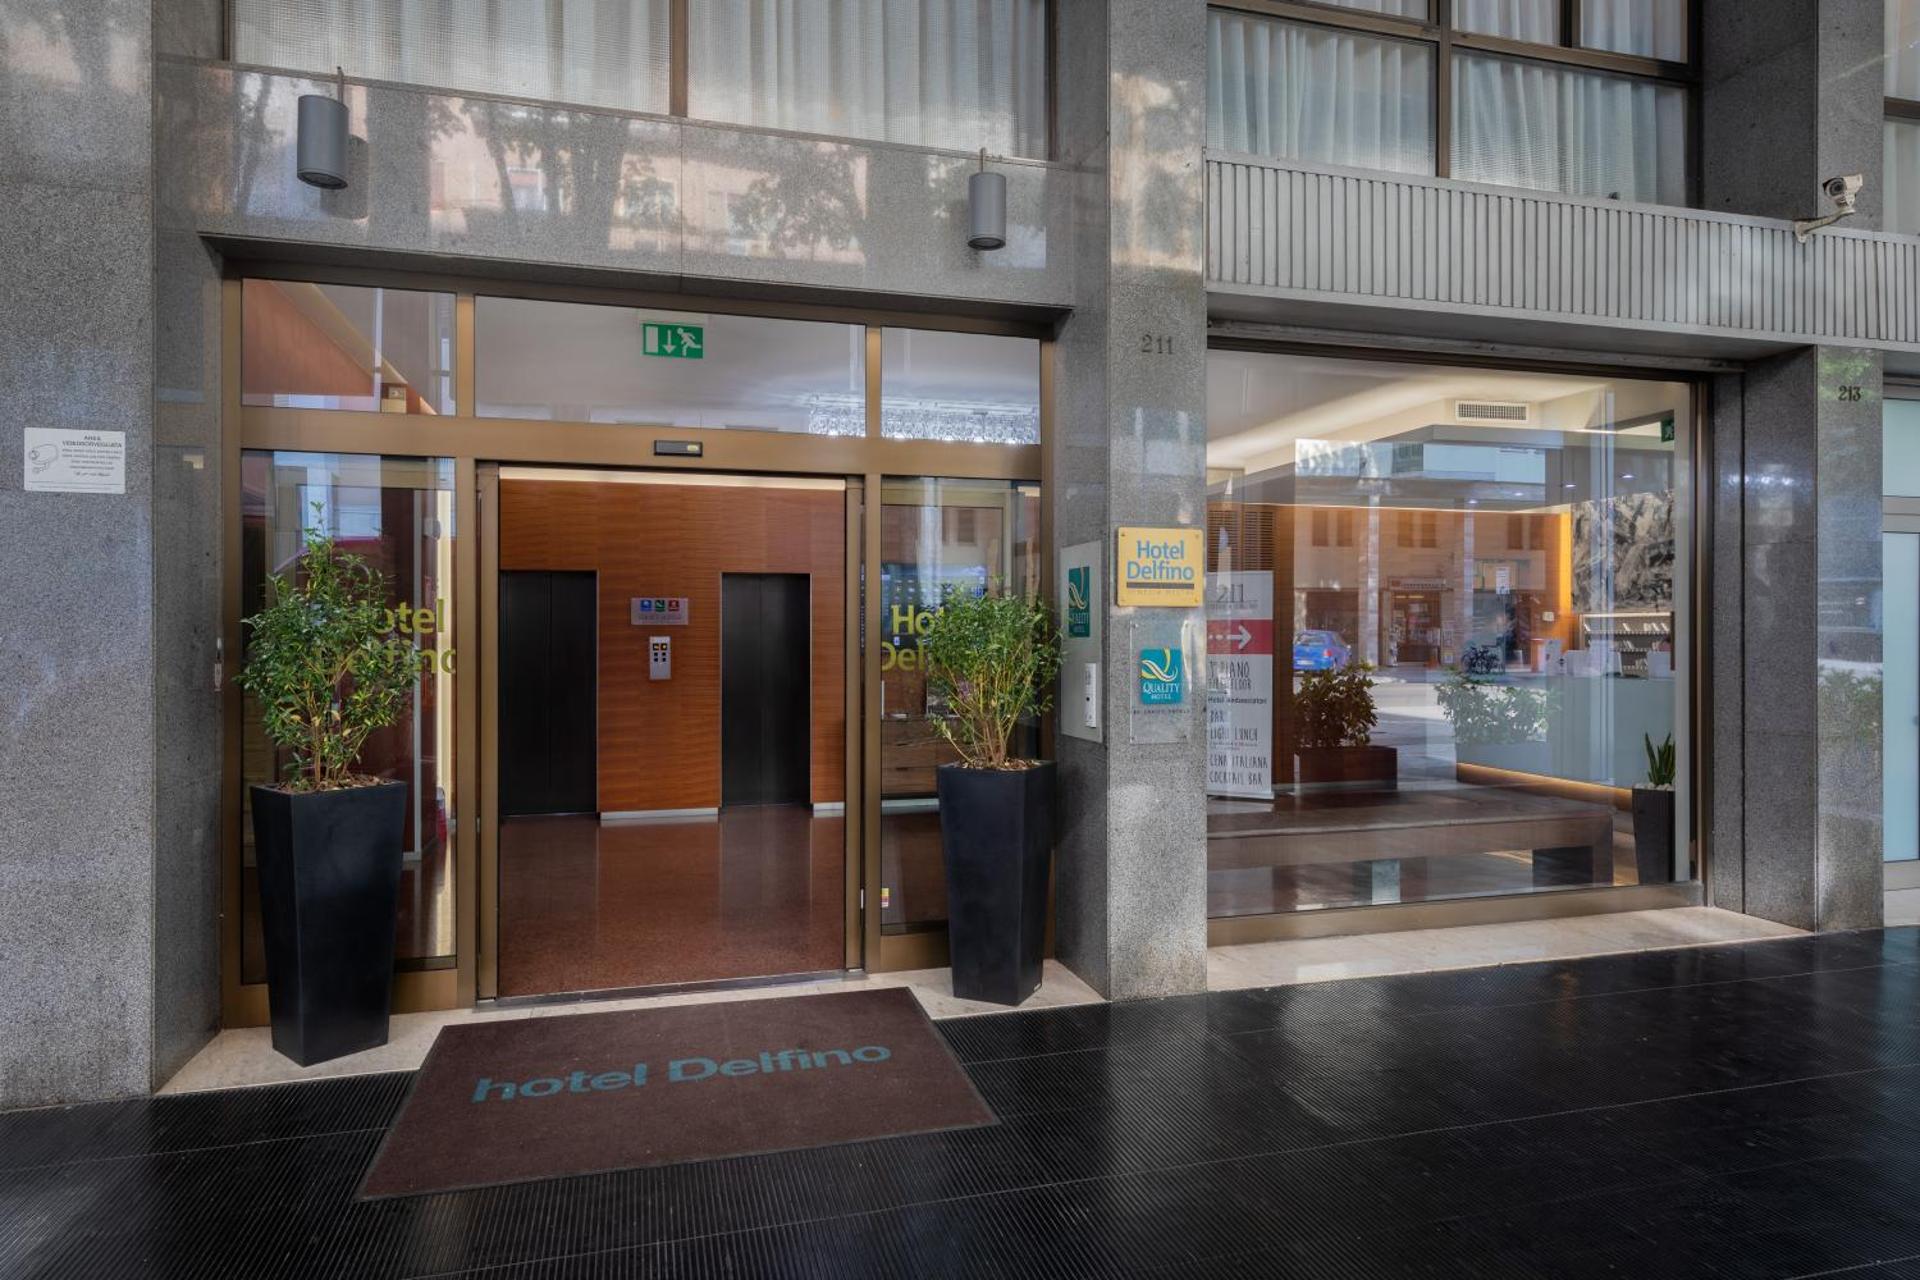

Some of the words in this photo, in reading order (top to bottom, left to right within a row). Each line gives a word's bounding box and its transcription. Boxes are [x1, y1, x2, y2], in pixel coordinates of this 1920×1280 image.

[1142, 333, 1174, 355] 211
[1838, 385, 1861, 402] 213
[1136, 539, 1184, 559] Hotel
[1127, 559, 1195, 580] Delfino
[1143, 682, 1180, 695] QUALITY
[472, 1062, 648, 1103] hotel
[667, 1046, 892, 1083] Delfino
